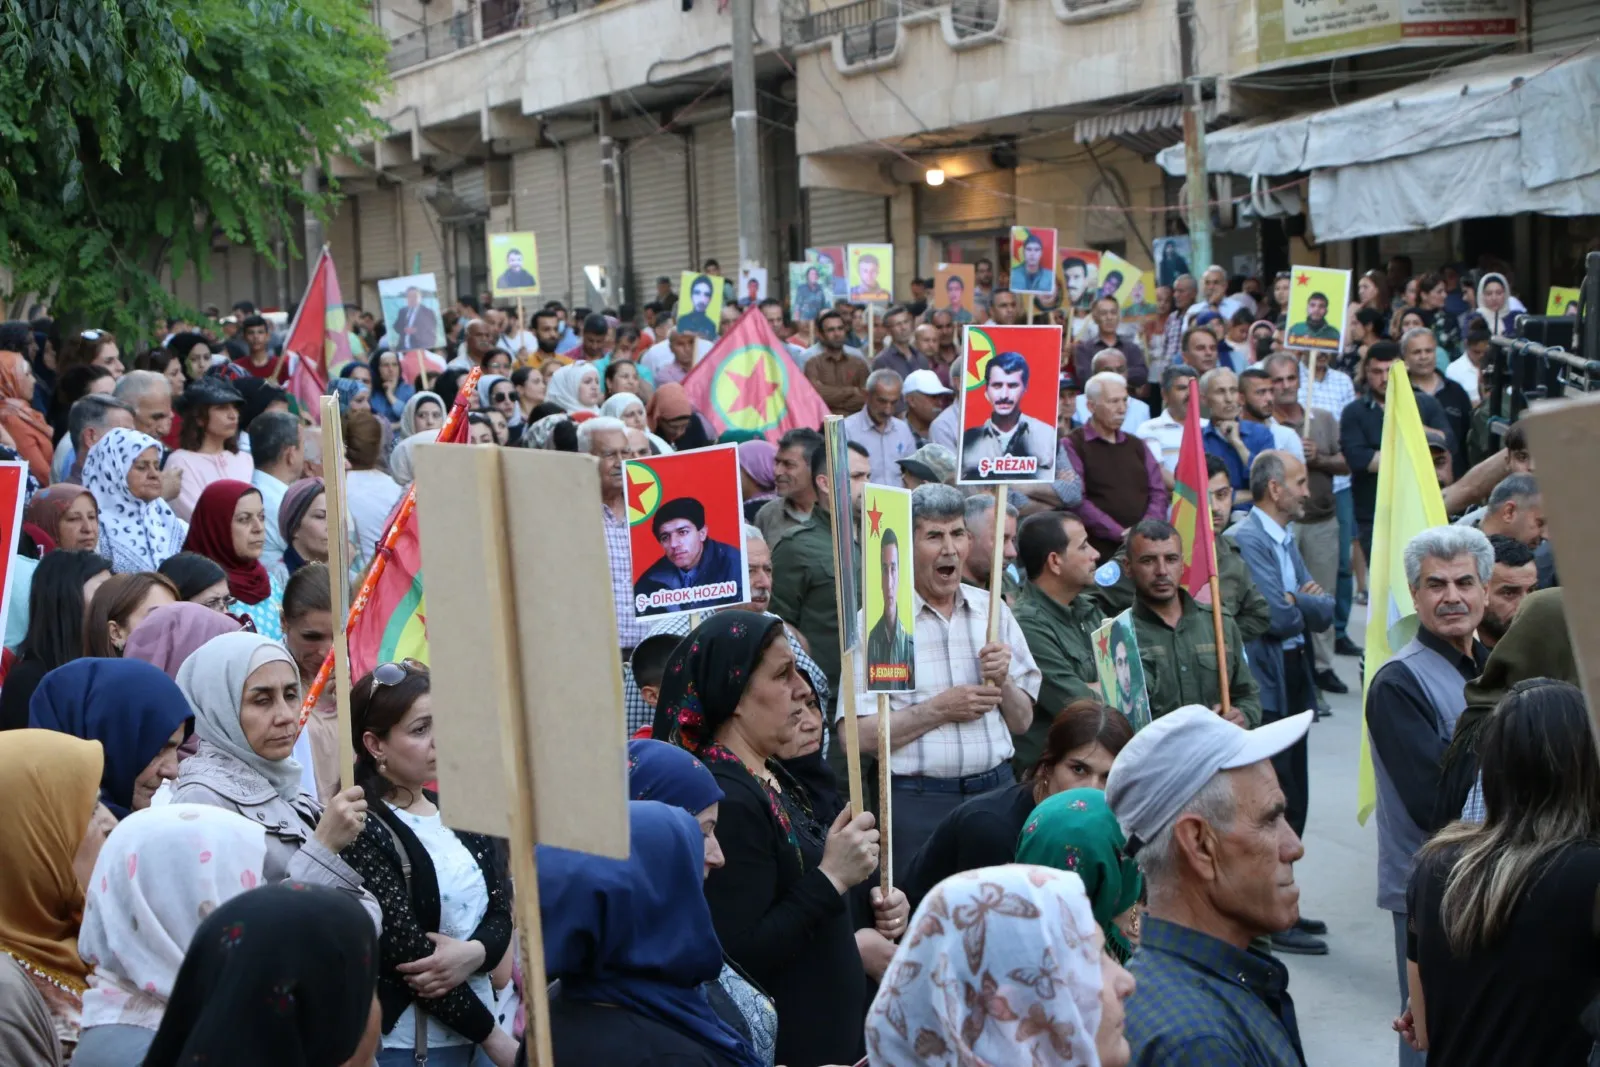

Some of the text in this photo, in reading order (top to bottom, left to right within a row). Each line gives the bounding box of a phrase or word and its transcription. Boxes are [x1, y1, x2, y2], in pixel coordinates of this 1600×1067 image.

[980, 455, 1035, 475] Ş- RÊZAN
[638, 595, 649, 610] Ş-
[694, 583, 735, 599] HOZAN
